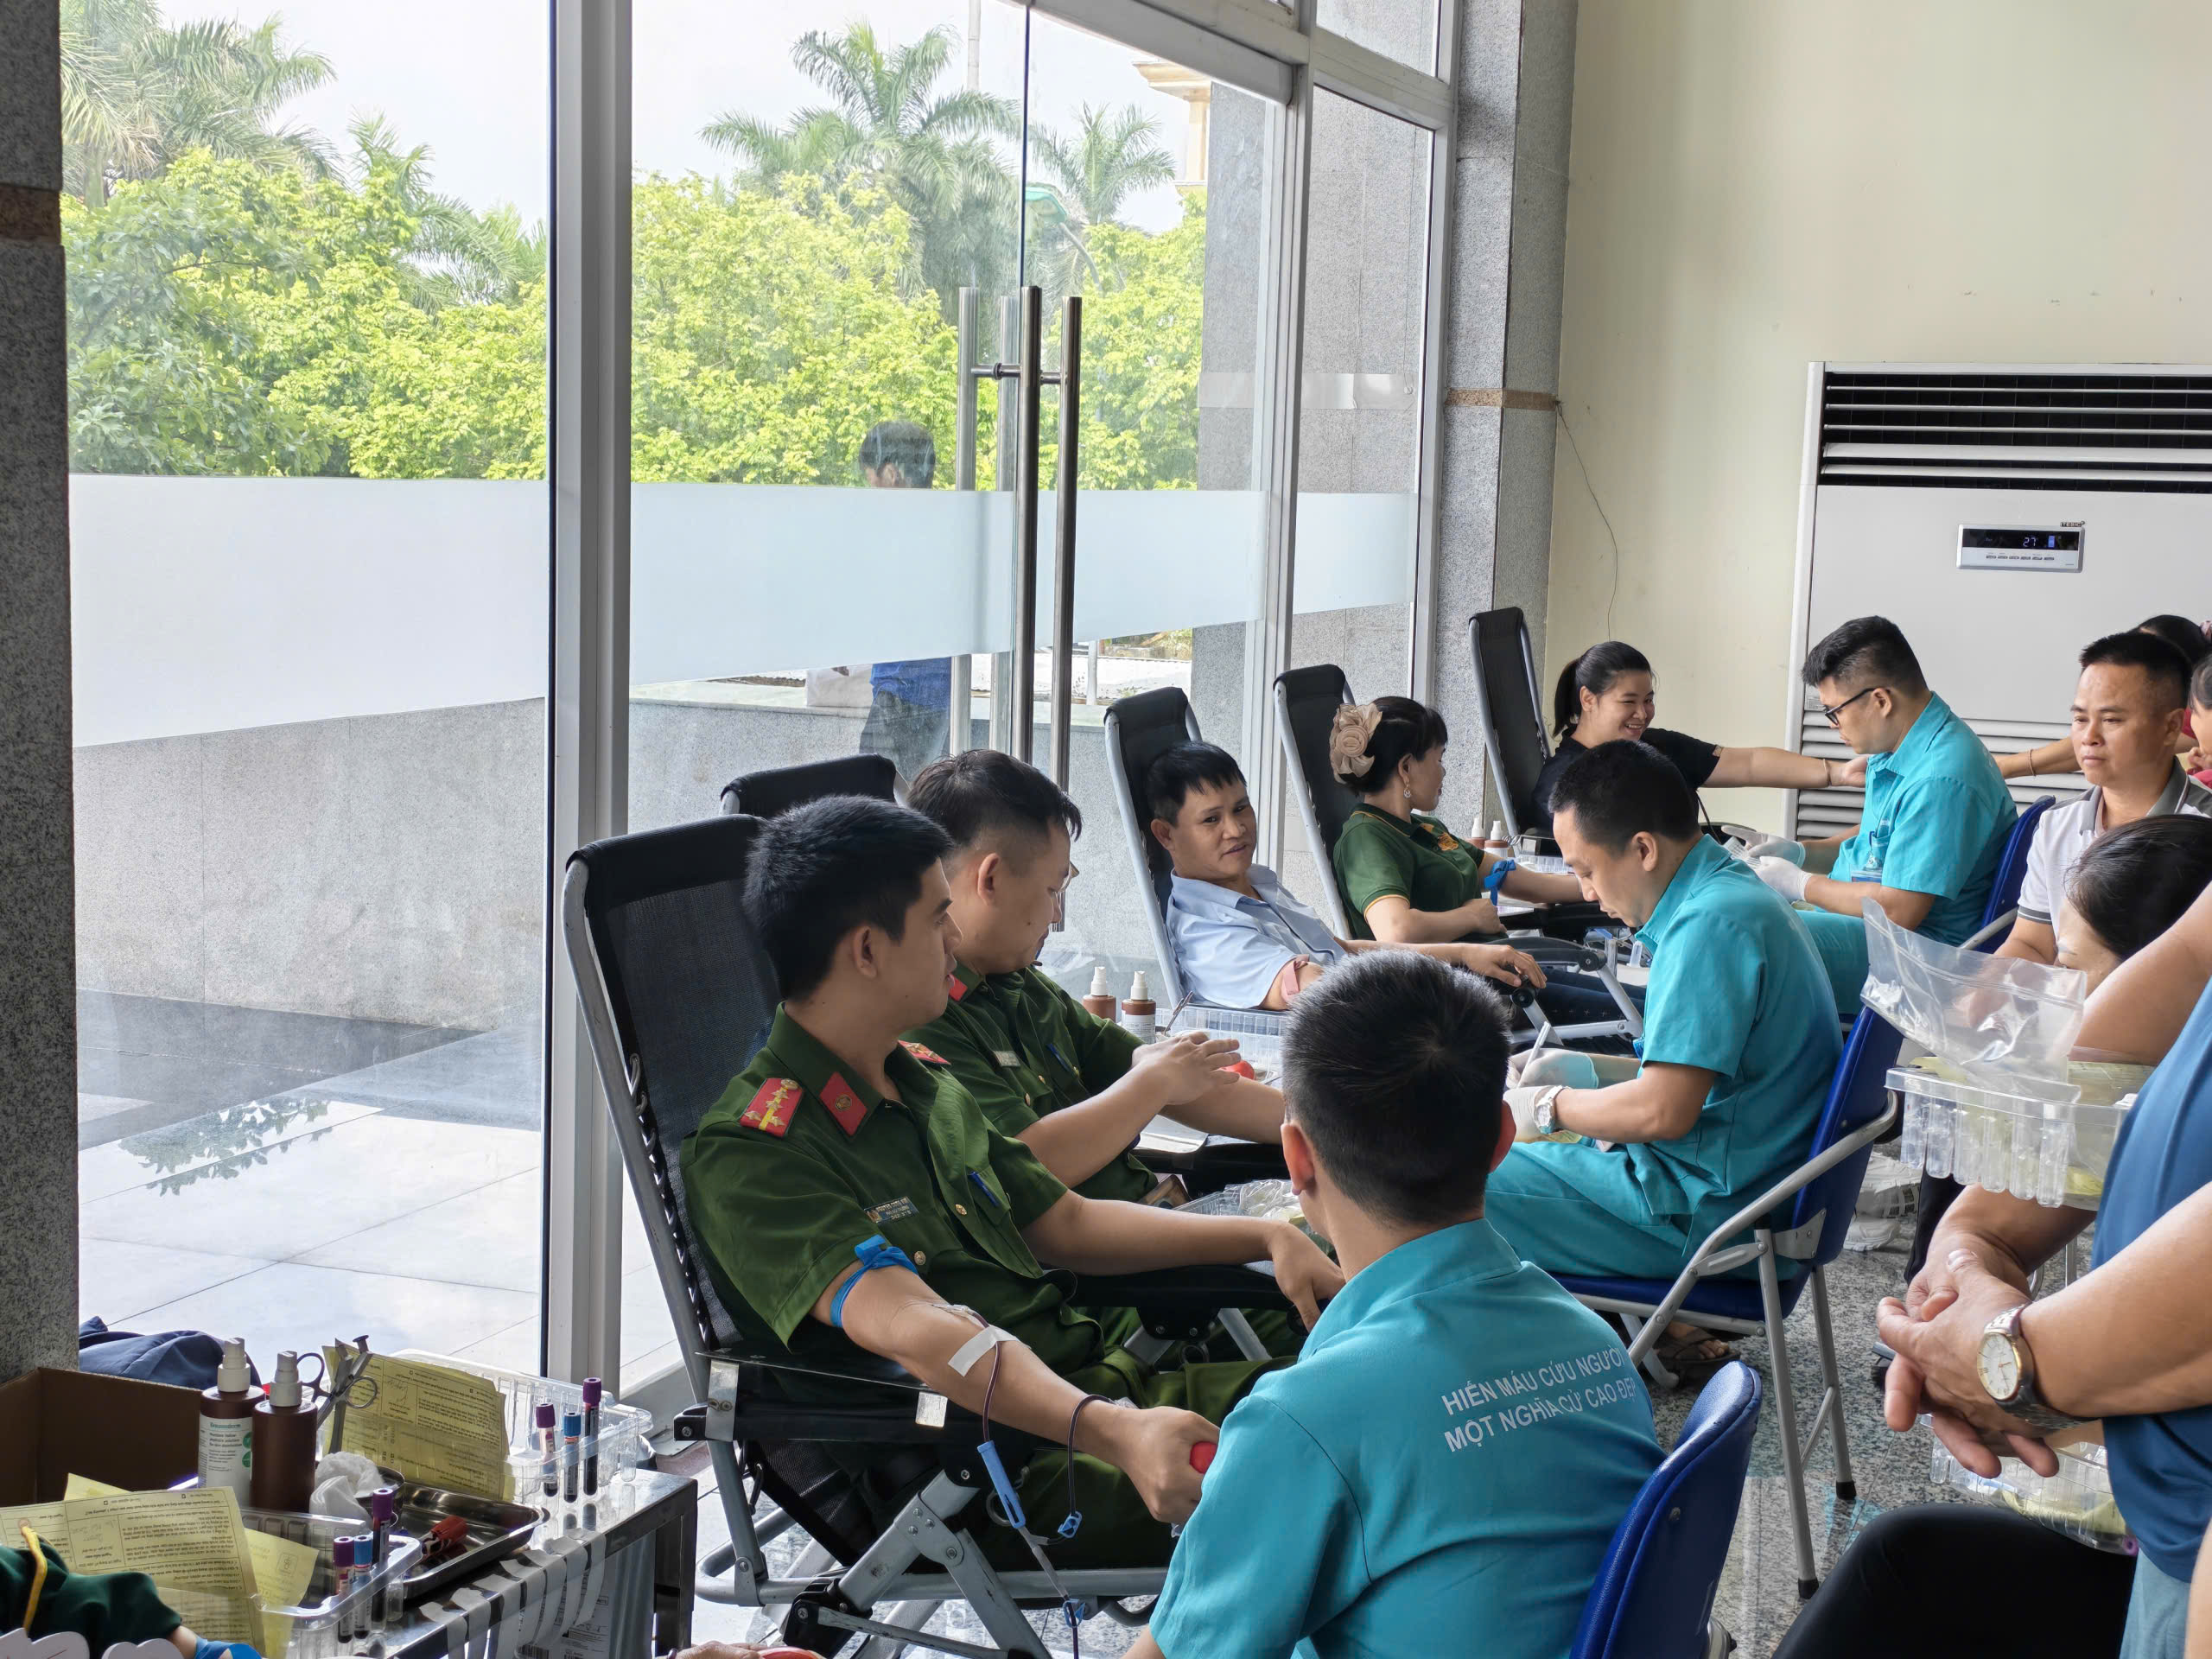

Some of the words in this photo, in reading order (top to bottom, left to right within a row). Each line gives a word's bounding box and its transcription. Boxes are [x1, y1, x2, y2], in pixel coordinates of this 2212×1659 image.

[1441, 1380, 1498, 1415] HIẾN
[1494, 1370, 1538, 1396] MÁU
[1538, 1360, 1577, 1387] CỨU
[1575, 1344, 1624, 1377] NGƯỜI
[1444, 1414, 1495, 1452] MỘT
[1498, 1396, 1564, 1432] NGHĨA
[1558, 1389, 1583, 1413] CỬ
[1585, 1383, 1618, 1408] CAO
